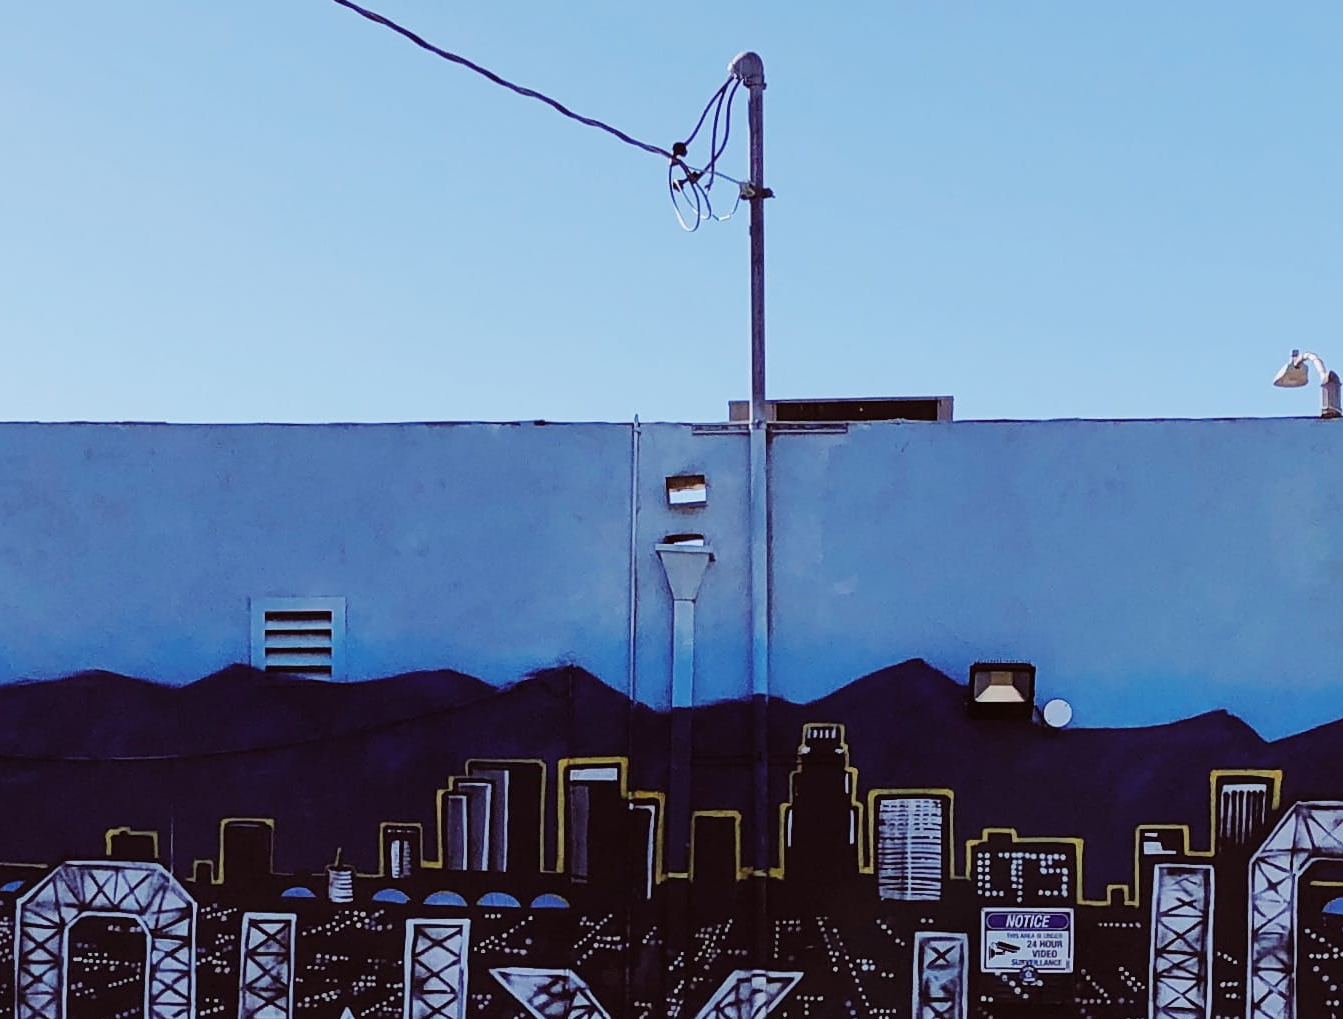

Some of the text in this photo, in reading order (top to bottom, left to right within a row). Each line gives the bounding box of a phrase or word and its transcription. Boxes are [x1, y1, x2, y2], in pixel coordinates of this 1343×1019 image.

[977, 852, 1069, 902] LTS
[1006, 915, 1051, 928] NOTICE
[1027, 940, 1063, 949] 24 HOUR
[1032, 950, 1058, 958] VIDEO
